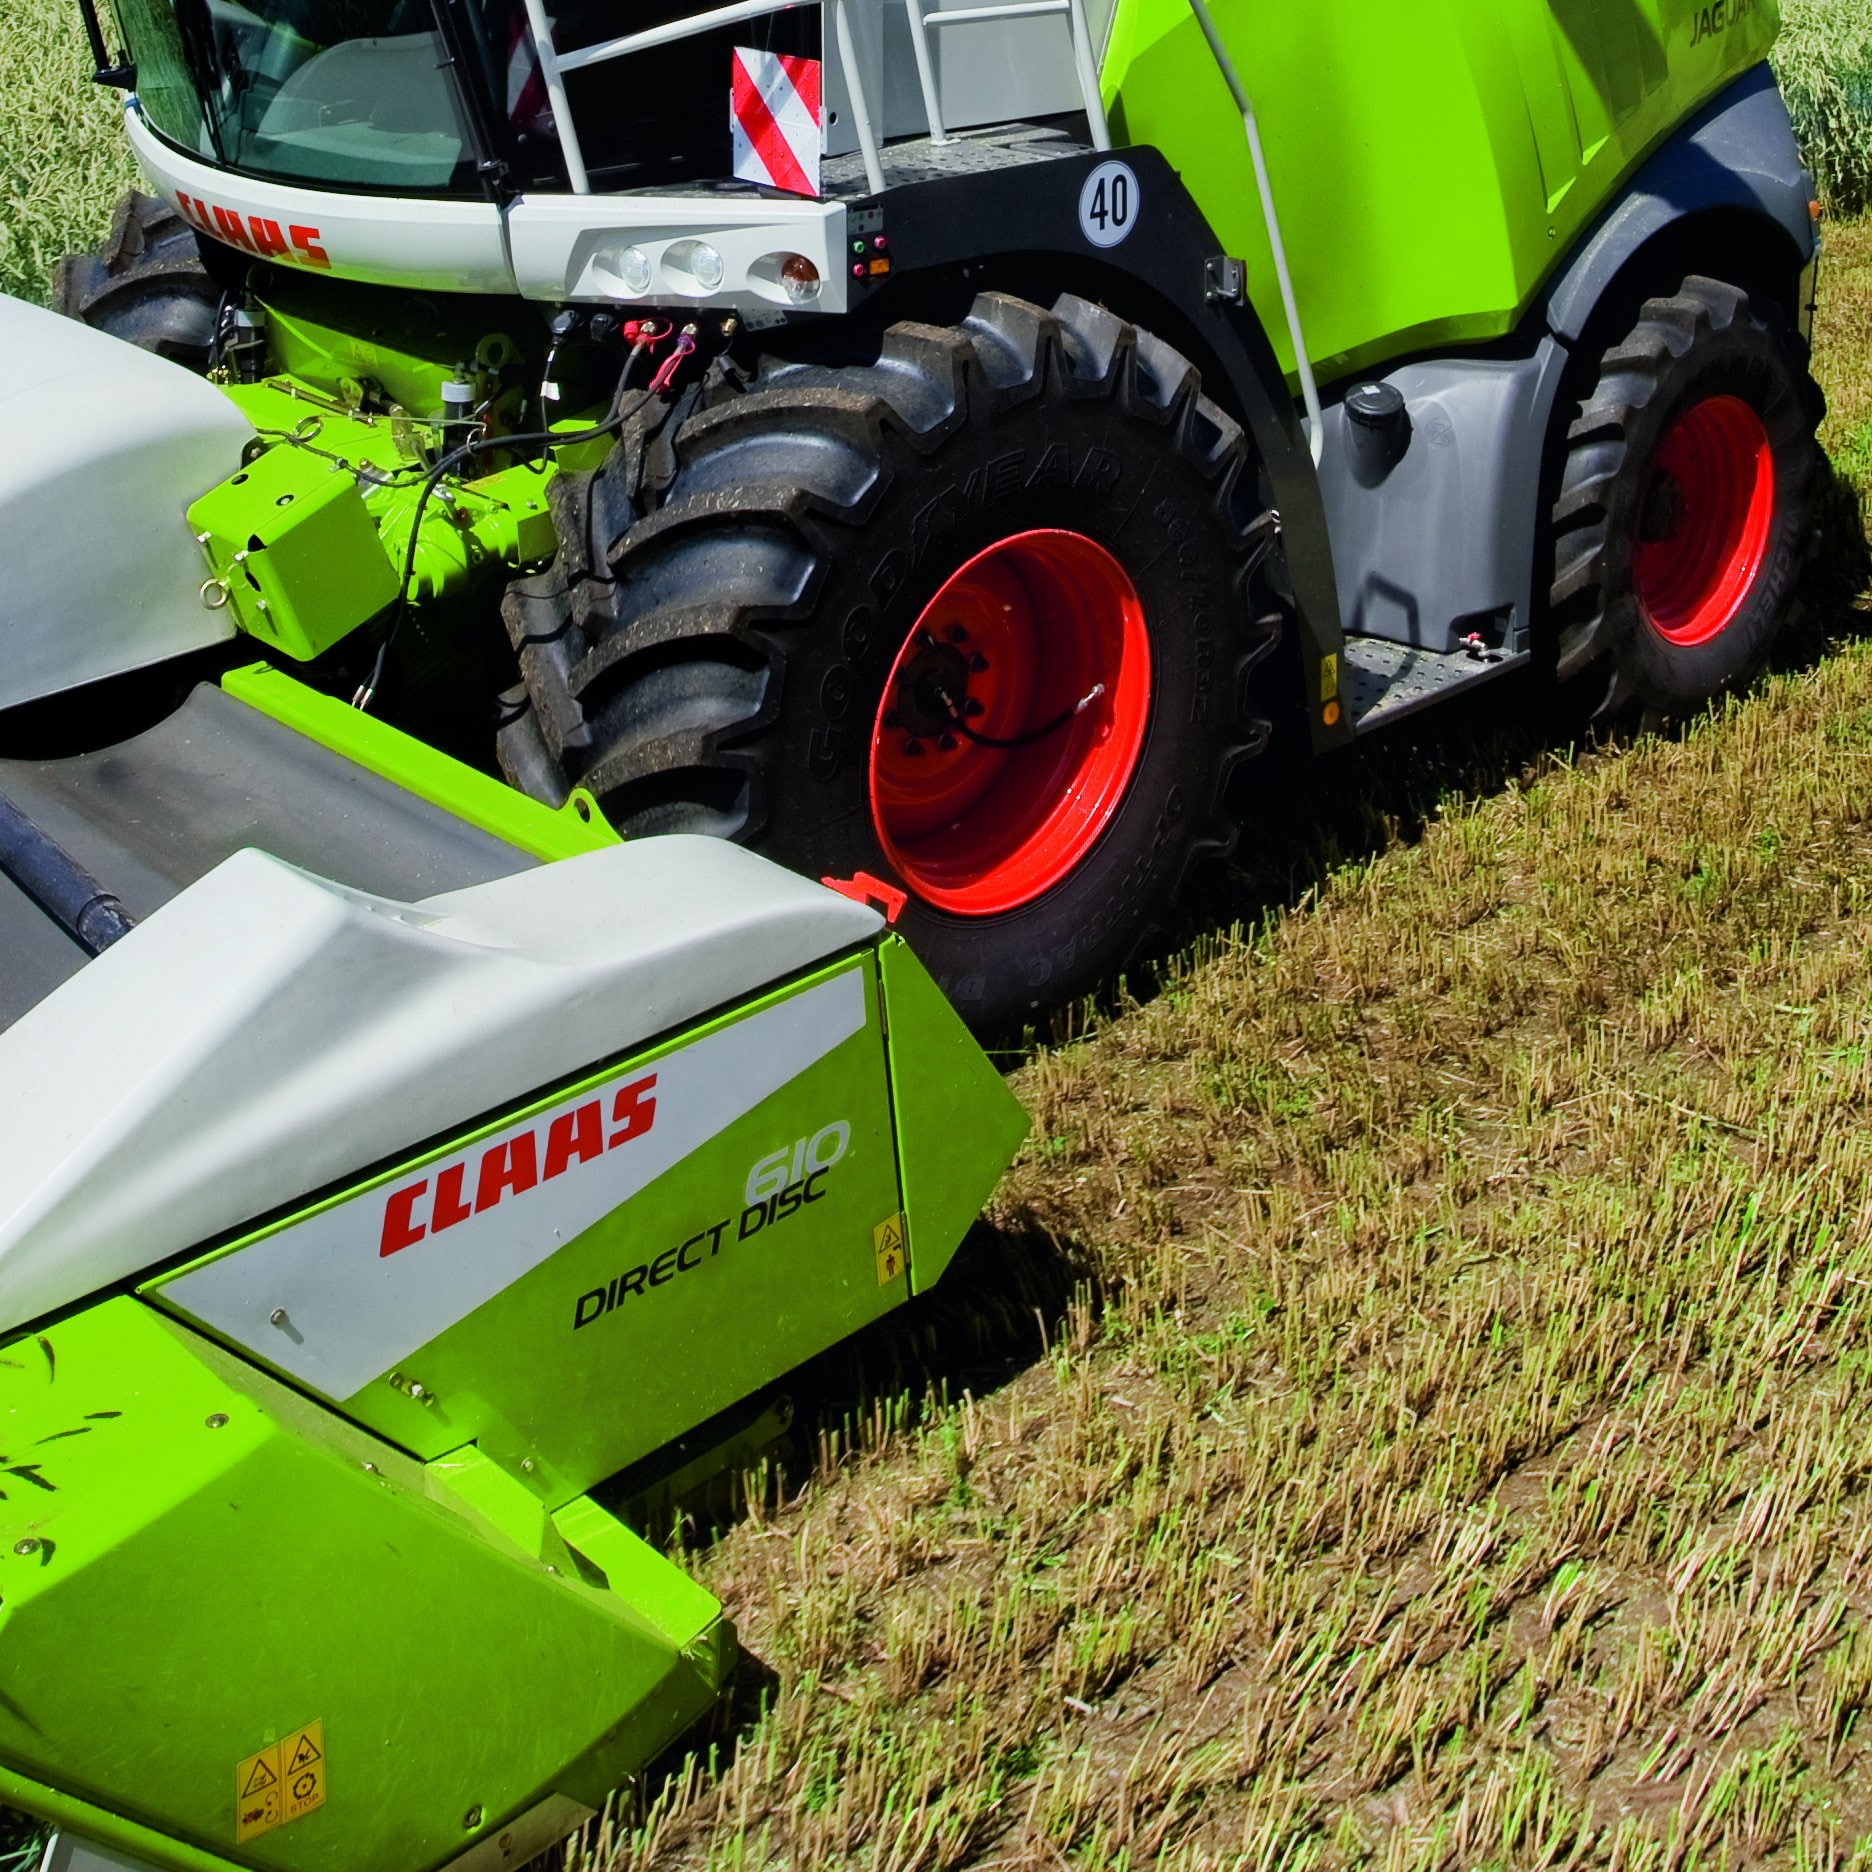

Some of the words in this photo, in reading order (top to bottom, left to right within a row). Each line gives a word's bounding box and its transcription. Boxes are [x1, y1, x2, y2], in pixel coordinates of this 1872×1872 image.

[175, 189, 332, 270] CLAAS
[1090, 174, 1127, 230] 40
[379, 1072, 657, 1258] CLAAS
[744, 1119, 851, 1208] 610
[573, 1219, 730, 1330] DIRECT
[737, 1166, 829, 1242] DISC
[290, 1793, 319, 1814] STOP
